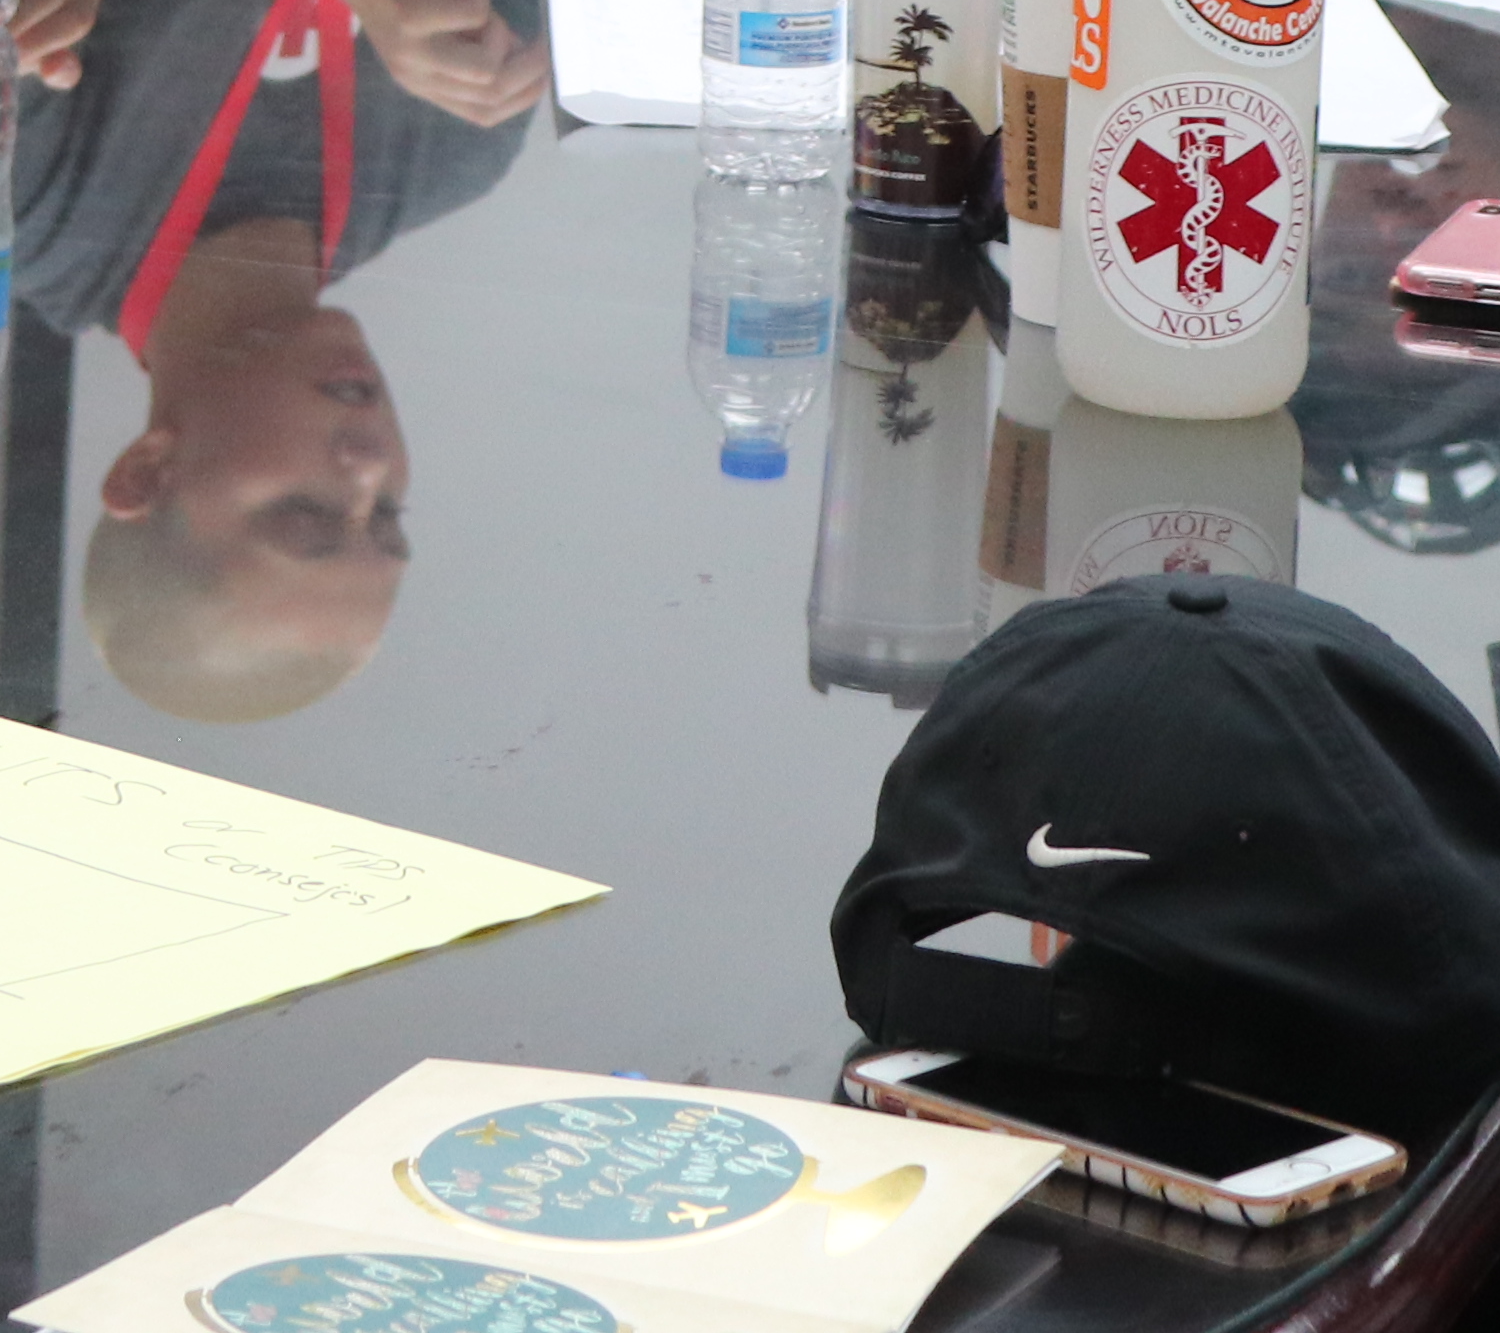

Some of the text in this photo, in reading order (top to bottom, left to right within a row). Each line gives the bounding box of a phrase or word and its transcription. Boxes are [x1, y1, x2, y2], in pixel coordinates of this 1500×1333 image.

[1025, 89, 1038, 211] STARBUCKS
[1088, 85, 1306, 278] WILDERNESS MEDICINE INSTITUTE
[1156, 308, 1244, 337] NOLS
[313, 844, 426, 881] TIPS
